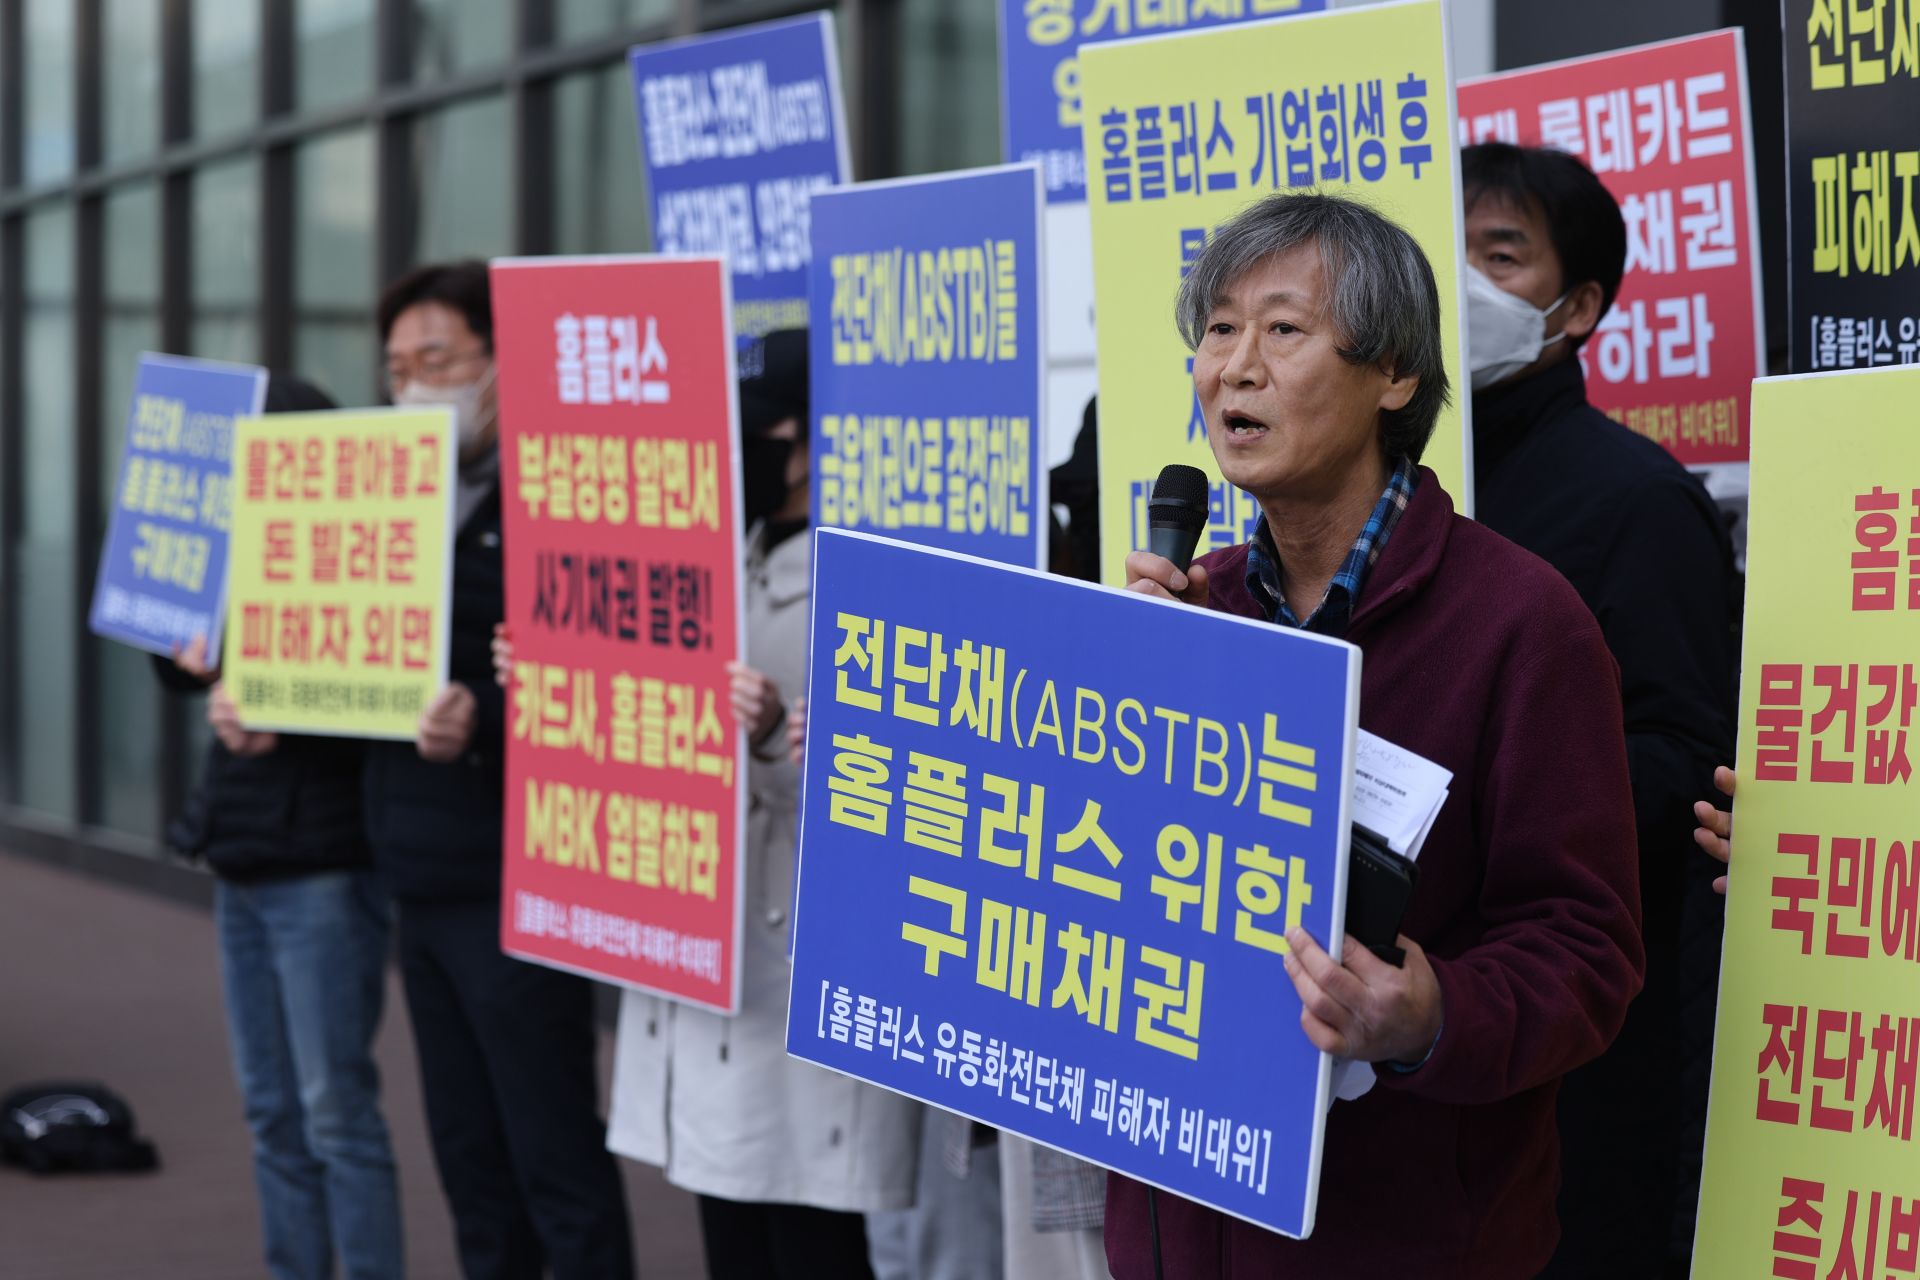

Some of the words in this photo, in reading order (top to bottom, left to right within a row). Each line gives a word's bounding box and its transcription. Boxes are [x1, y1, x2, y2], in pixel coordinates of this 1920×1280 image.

[1100, 99, 1238, 203] 홈플러스
[1246, 79, 1387, 190] 기업회생
[1396, 72, 1432, 180] 후
[555, 312, 670, 404] 홈플러스
[830, 238, 1017, 367] 전단채(ABSTB)를
[1577, 292, 1715, 384] 하라
[1811, 315, 1893, 369] [홈플러스
[1897, 316, 1920, 366] 유
[245, 436, 325, 502] 물건은
[518, 431, 630, 526] 부실경영
[633, 436, 721, 533] 알면서
[820, 414, 943, 529] 금융채권으로
[946, 415, 1030, 537] 결정하면
[263, 519, 297, 584] 돈
[310, 519, 417, 586] 빌려준
[532, 551, 638, 642] 사기채권
[1850, 485, 1920, 612] 홈
[240, 603, 351, 666] 피해자
[363, 604, 433, 672] 외면
[513, 660, 606, 765] 카드사,
[610, 669, 734, 788] 홈플러스,
[834, 611, 1318, 827] 전단채(ABSTB)는
[1755, 663, 1918, 786] 물건값
[525, 777, 602, 874] MBK
[605, 790, 721, 903] 엄벌하라
[827, 733, 1123, 903] 홈플러스
[1150, 823, 1314, 957] 위한
[901, 875, 1205, 1061] 구매채권
[817, 979, 925, 1064] [홈플러스
[933, 1021, 1086, 1125] 유동화전단채
[1090, 1077, 1171, 1157] 피해자
[1177, 1107, 1273, 1196] 비대위]
[1756, 1003, 1920, 1142] 전단채
